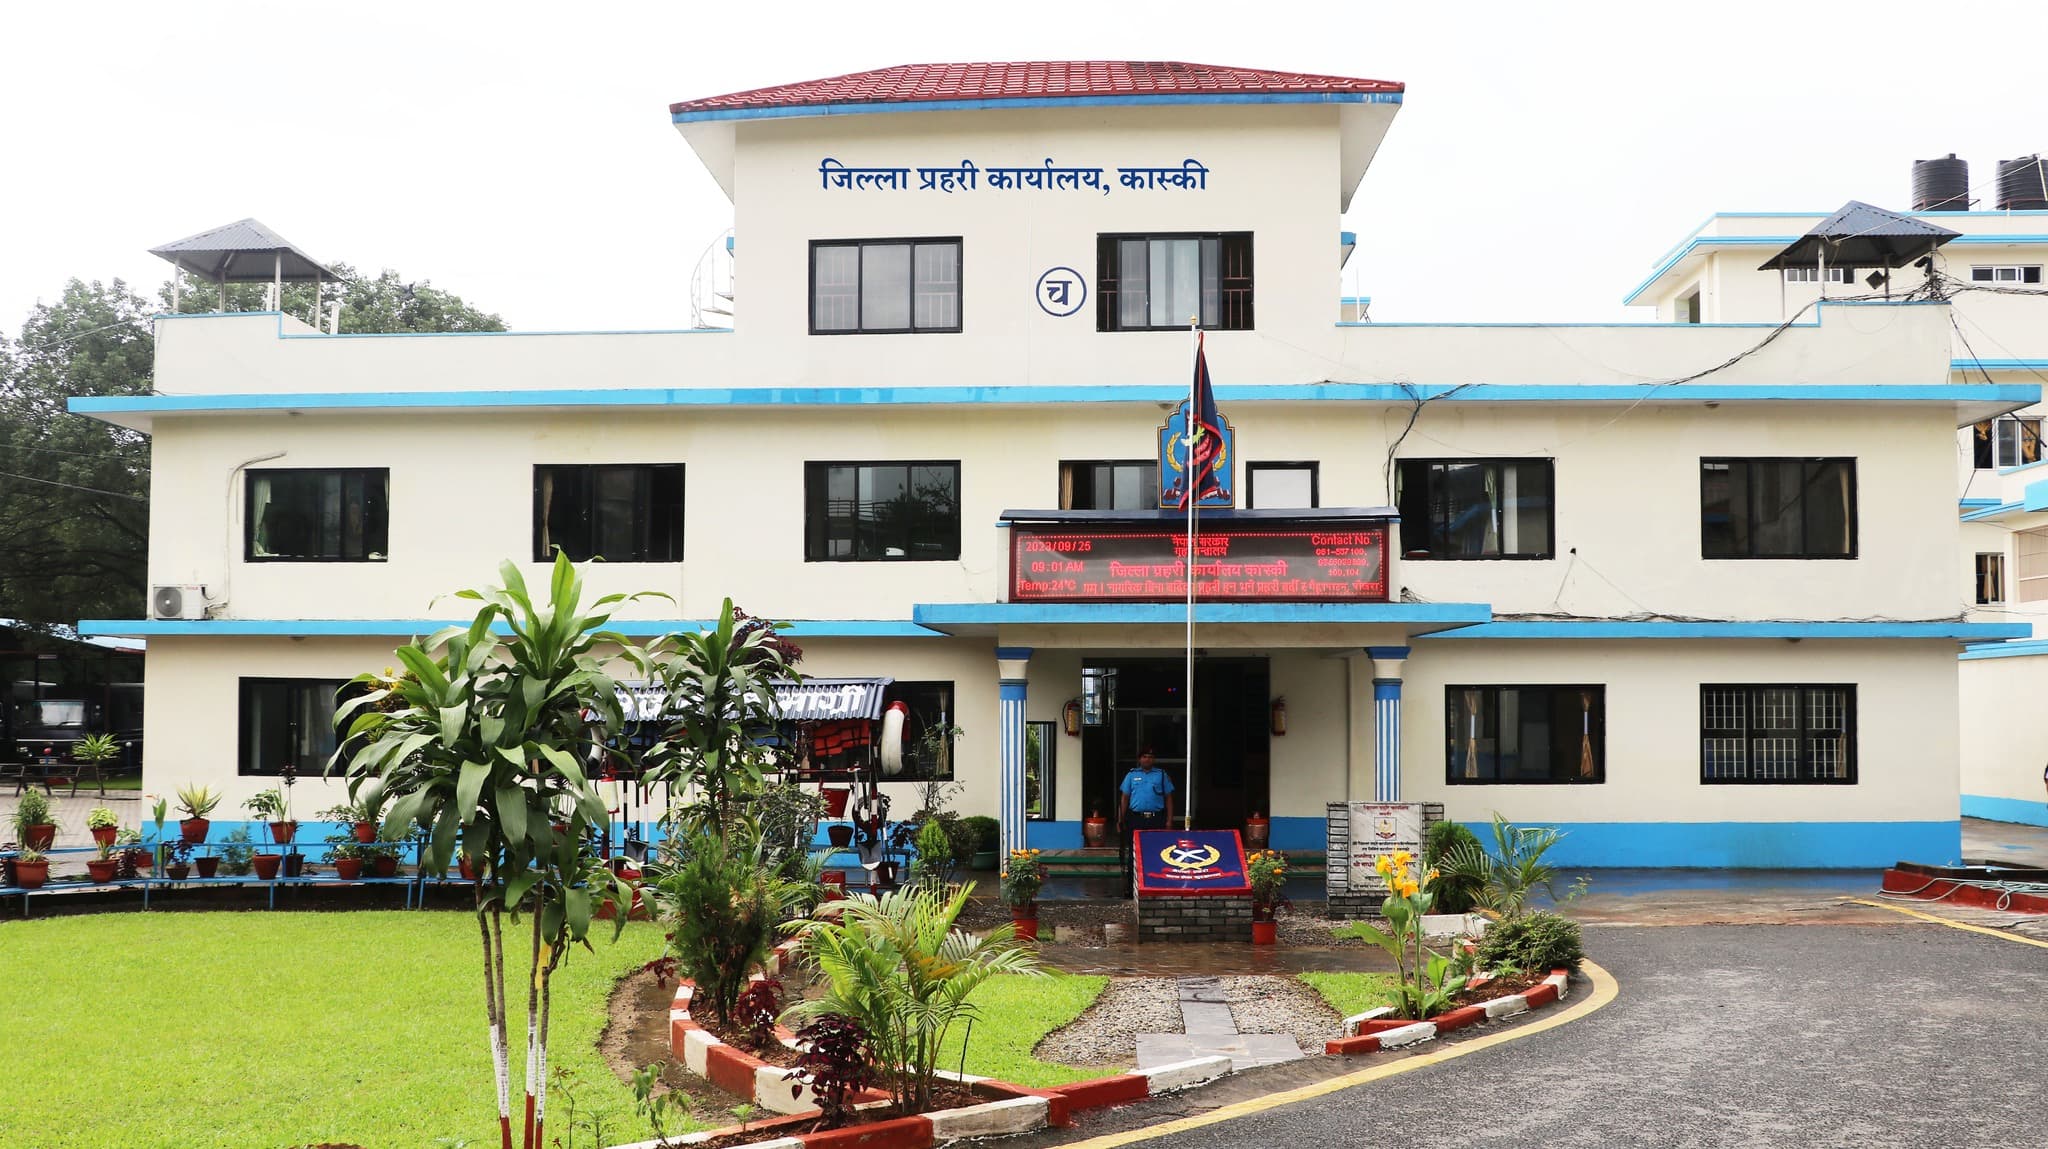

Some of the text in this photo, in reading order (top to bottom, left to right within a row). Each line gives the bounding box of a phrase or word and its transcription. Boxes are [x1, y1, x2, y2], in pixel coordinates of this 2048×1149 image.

[819, 158, 1209, 196] जिल्ला प्रहरी कार्यालय, कास्की
[1046, 280, 1073, 306] च
[1312, 534, 1353, 546] Contact
[1065, 561, 1084, 573] AM
[1109, 560, 1150, 577] जिल्ला
[1152, 560, 1186, 578] प्रहरी
[1243, 560, 1288, 577] कास्की
